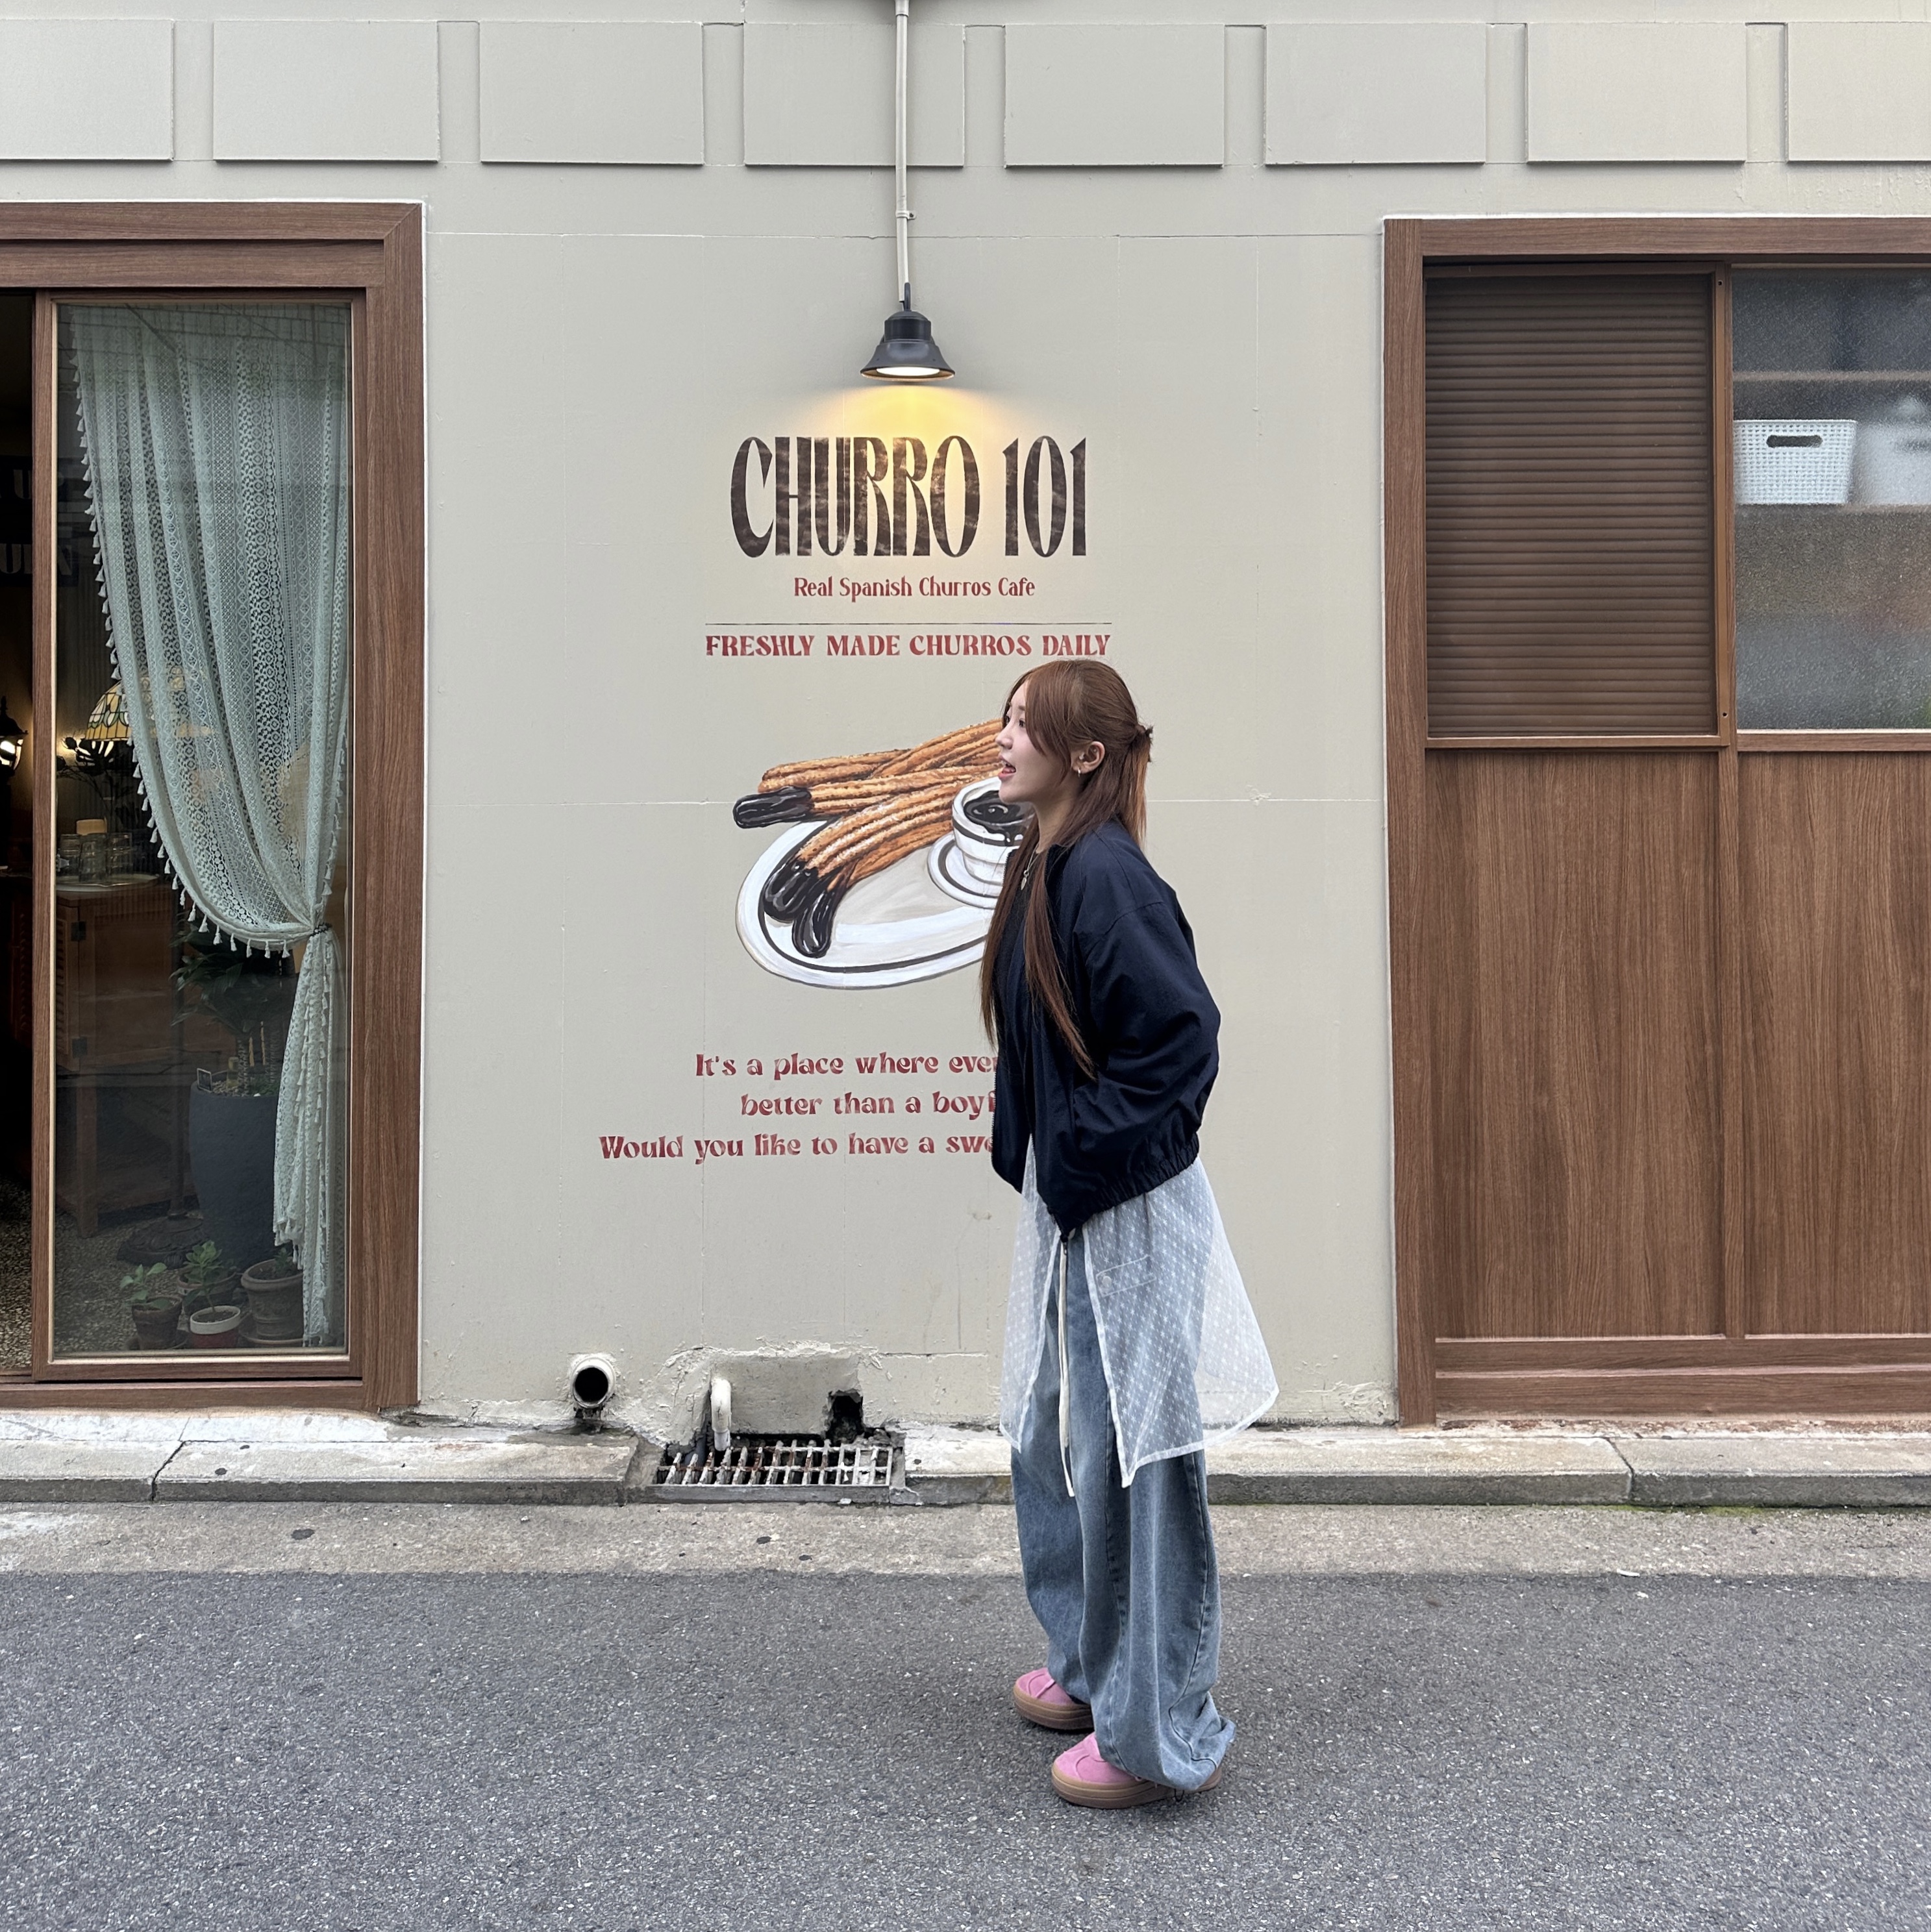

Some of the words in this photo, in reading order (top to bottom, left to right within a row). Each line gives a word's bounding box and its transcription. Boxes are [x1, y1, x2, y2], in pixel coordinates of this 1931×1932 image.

[730, 436, 980, 558] CHURRO
[1002, 436, 1087, 558] 101
[794, 576, 833, 597] Real
[840, 576, 913, 602] Spanish
[919, 576, 991, 597] Churros
[997, 577, 1036, 597] Cafe
[706, 634, 814, 657] FRESHLY
[827, 634, 900, 656] MADE
[908, 634, 1032, 656] CHURROS
[1042, 634, 1111, 656] DAILY
[696, 1054, 736, 1076] It's
[747, 1058, 763, 1076] a
[774, 1052, 843, 1081] place
[854, 1051, 939, 1074] where
[741, 1093, 822, 1117] better
[834, 1092, 895, 1115] than
[905, 1096, 921, 1113] a
[599, 1135, 683, 1159] Would
[695, 1139, 743, 1165] you
[754, 1133, 801, 1156] like
[811, 1136, 838, 1156] to
[849, 1132, 909, 1155] have
[919, 1137, 935, 1154] a
